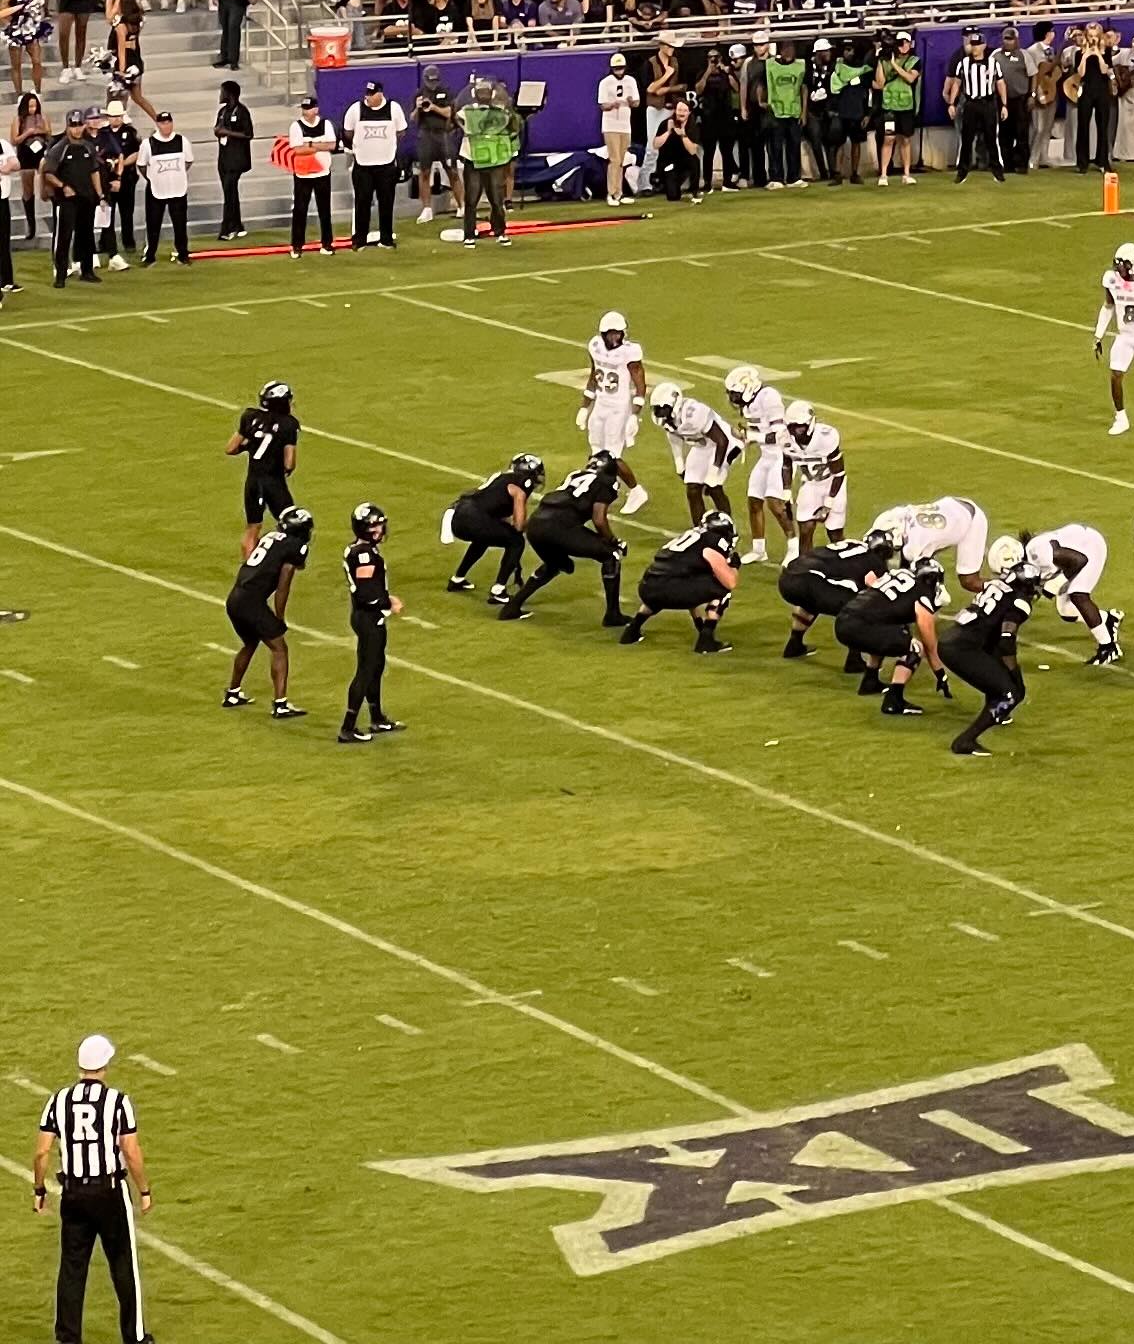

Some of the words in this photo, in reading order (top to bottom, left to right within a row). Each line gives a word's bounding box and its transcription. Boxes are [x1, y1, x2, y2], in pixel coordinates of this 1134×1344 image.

[253, 430, 273, 460] 7
[246, 534, 275, 567] 6
[72, 1103, 99, 1141] R
